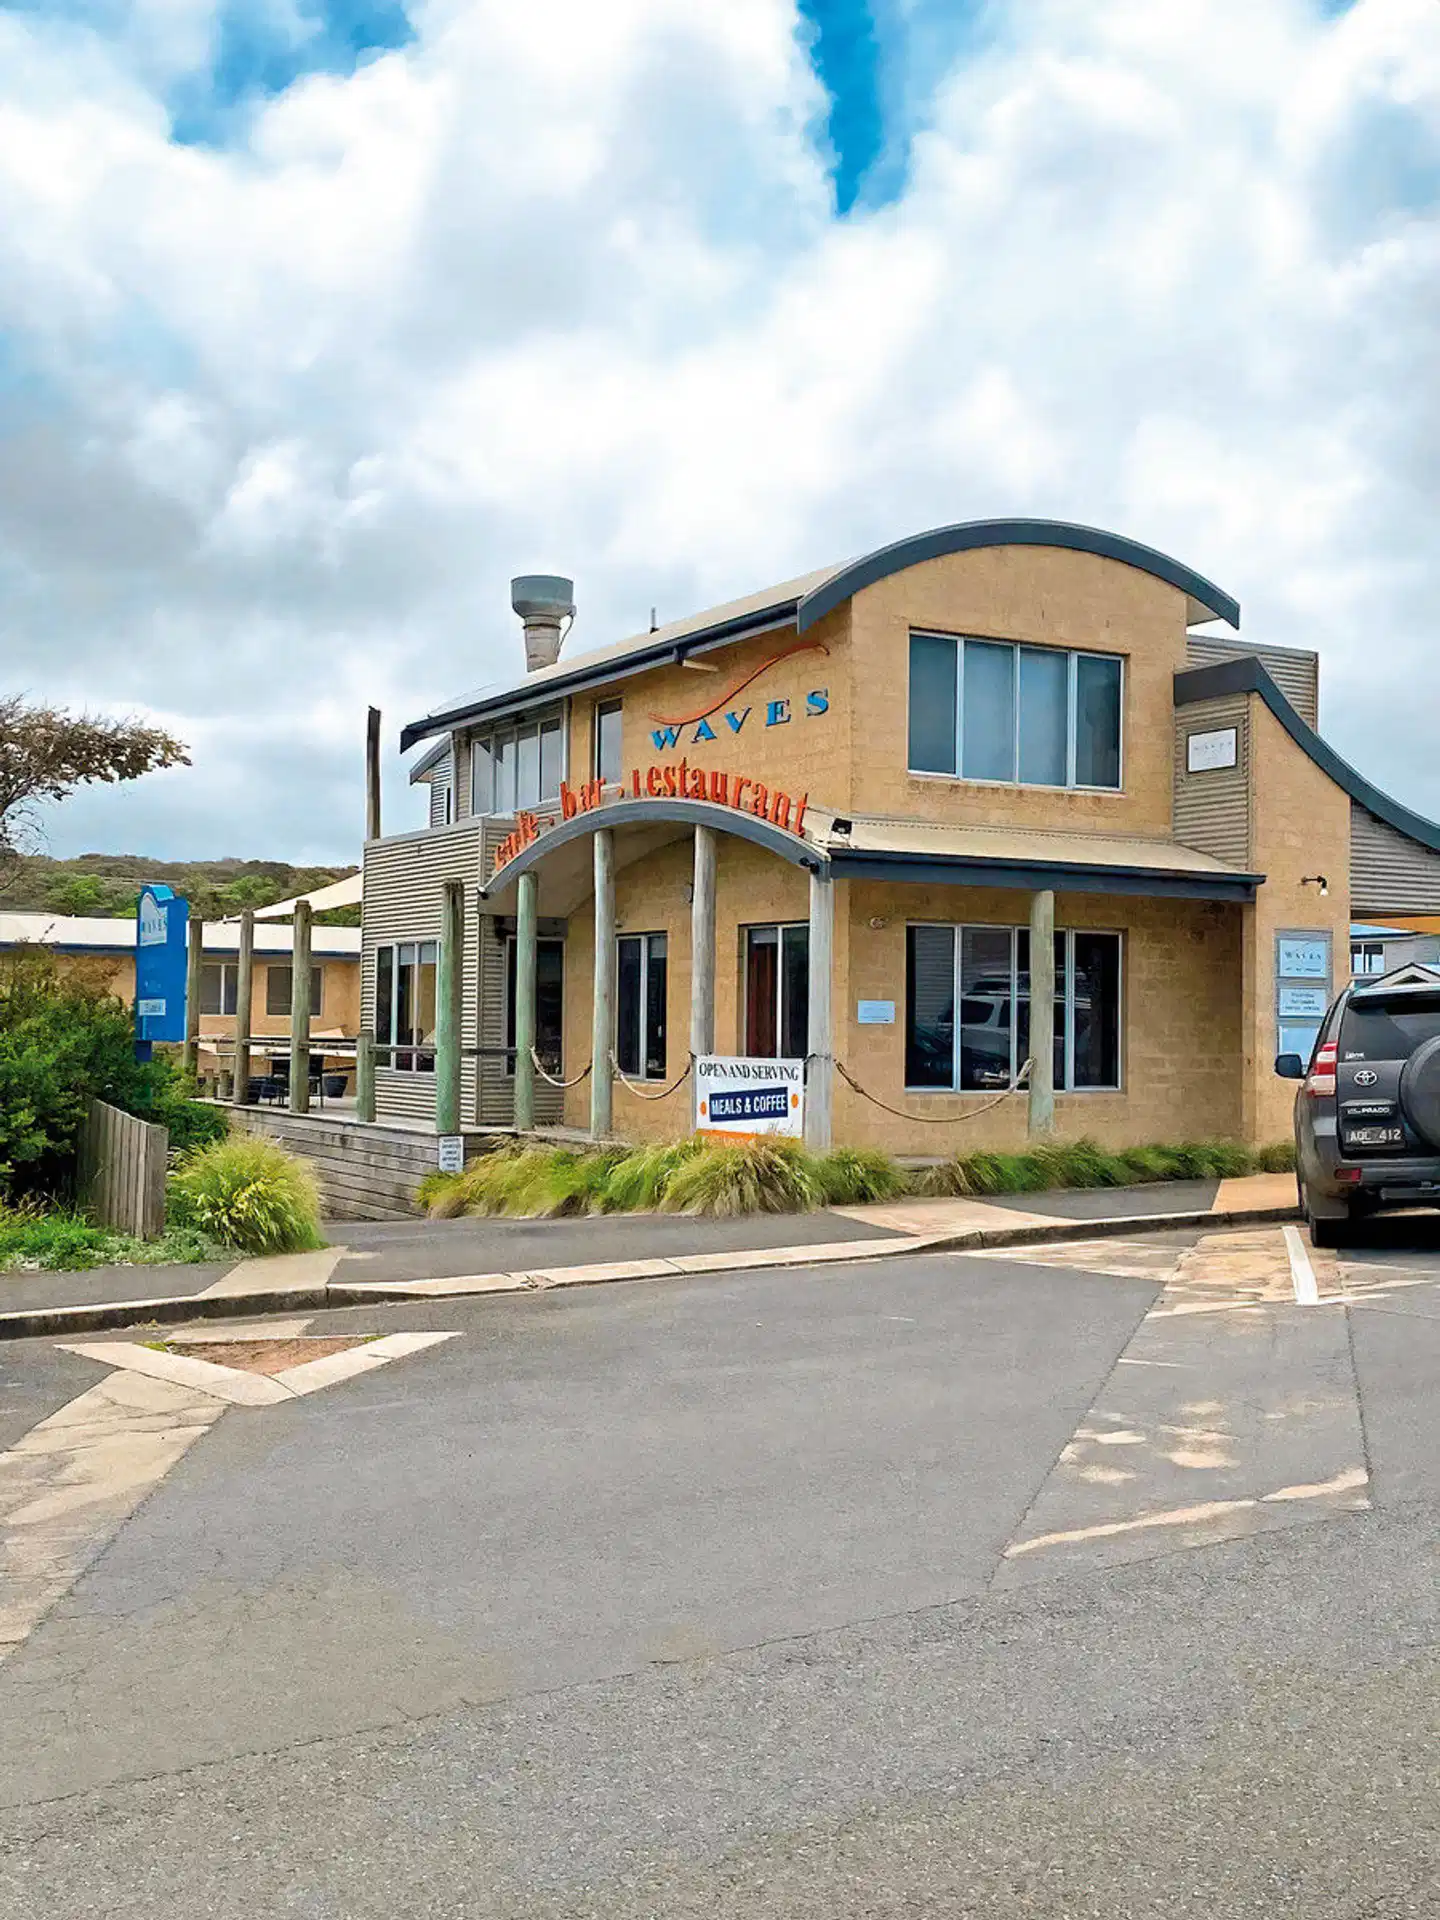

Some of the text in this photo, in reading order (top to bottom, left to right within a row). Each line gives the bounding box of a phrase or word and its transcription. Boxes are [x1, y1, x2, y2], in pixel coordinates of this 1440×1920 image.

[650, 688, 830, 751] WAVES
[560, 780, 606, 820] bar
[632, 757, 809, 837] restaurant
[699, 1063, 799, 1081] OPEN AND SERVING
[711, 1095, 787, 1116] MEALS & COFFEE
[1379, 1129, 1402, 1141] 412
